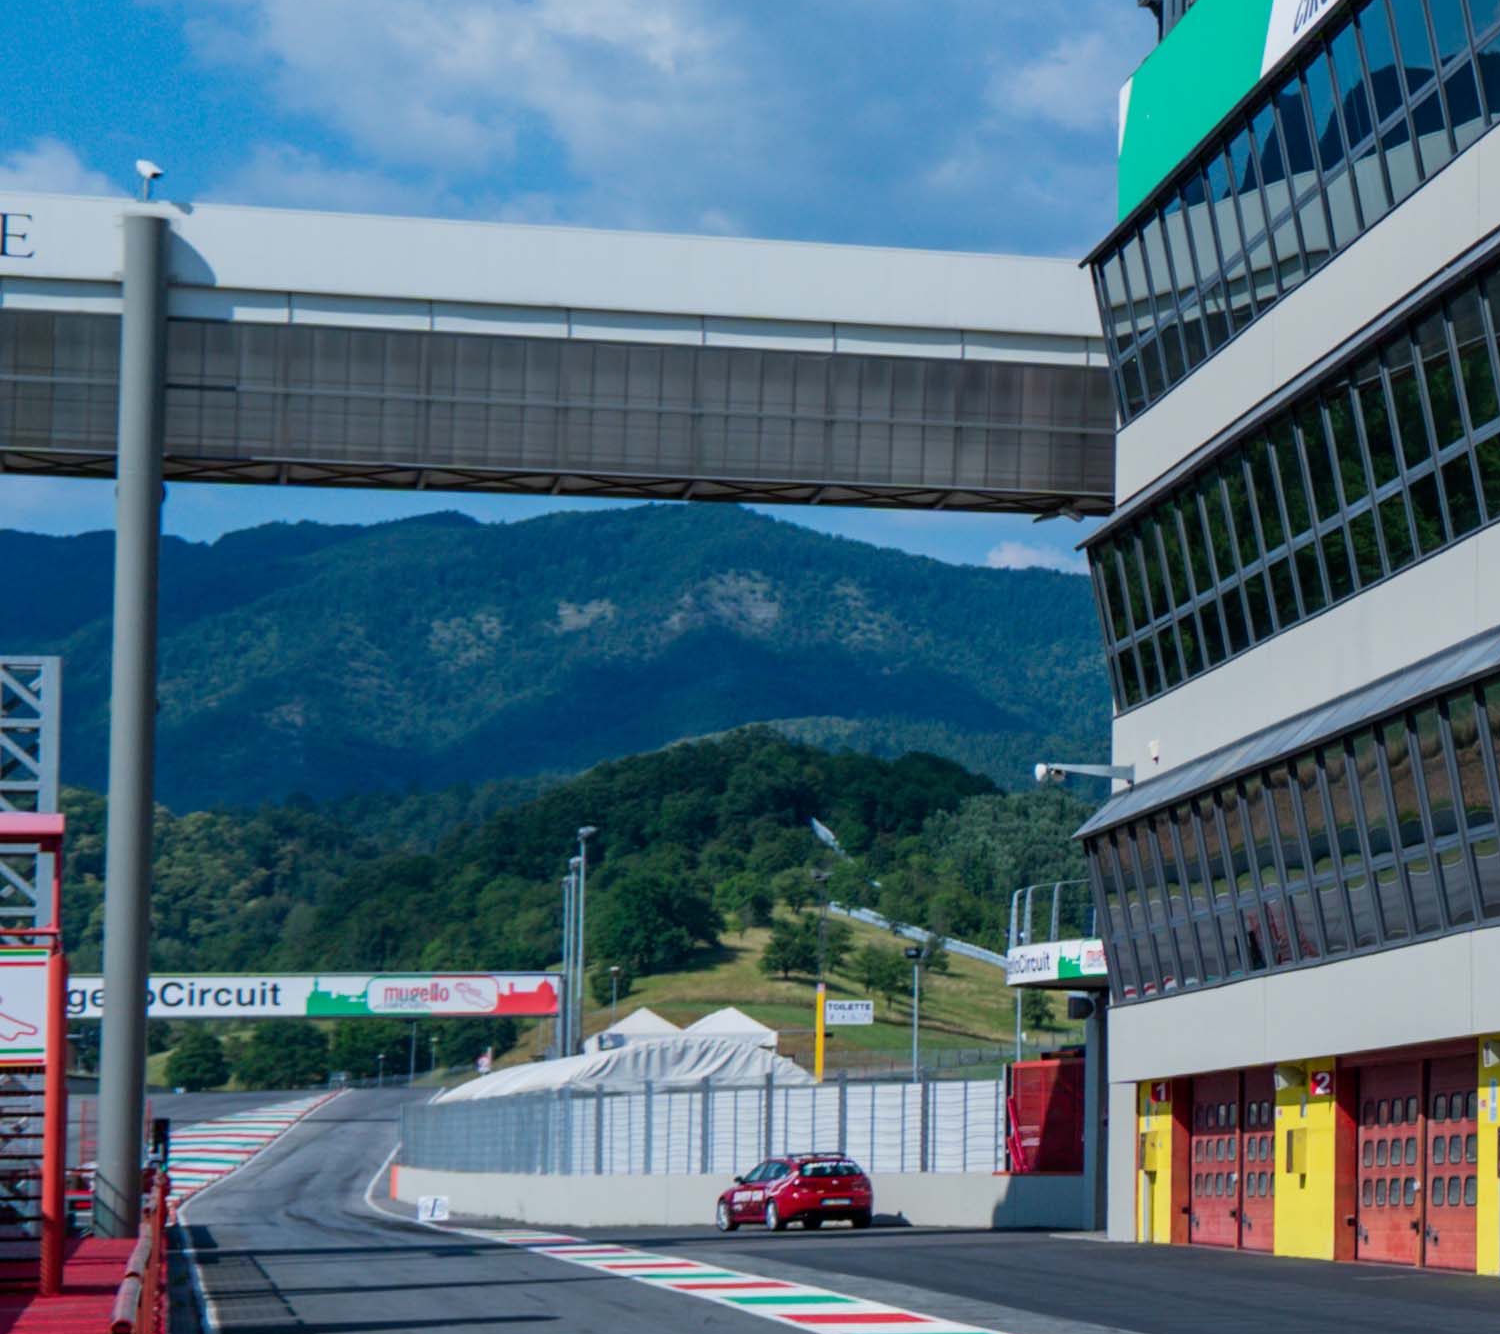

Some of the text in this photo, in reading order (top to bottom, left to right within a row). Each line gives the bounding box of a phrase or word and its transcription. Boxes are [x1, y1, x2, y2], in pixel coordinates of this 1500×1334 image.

[384, 982, 450, 1004] mugello
[828, 1002, 872, 1011] TOILETTE
[1156, 1083, 1166, 1101] 1
[1315, 1072, 1331, 1095] 2
